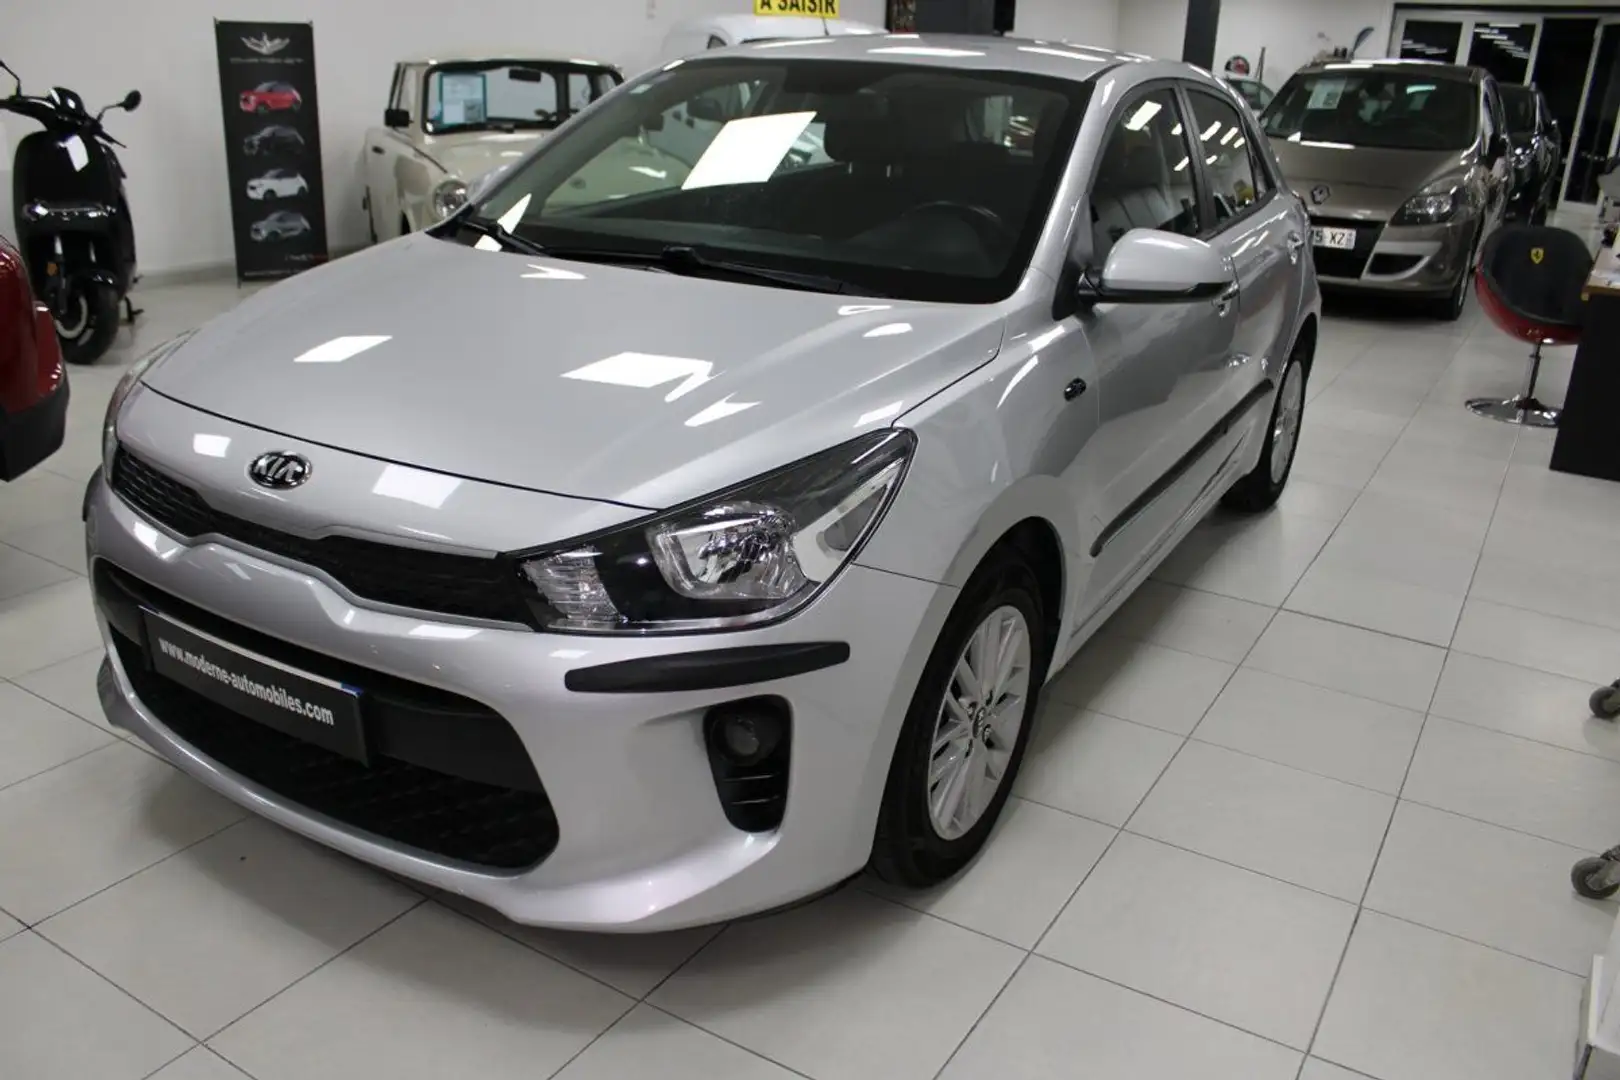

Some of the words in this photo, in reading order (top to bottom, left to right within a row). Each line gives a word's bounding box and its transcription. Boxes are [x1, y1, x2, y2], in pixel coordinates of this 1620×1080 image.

[778, 0, 836, 14] SAISIR
[253, 454, 304, 482] KIA
[158, 637, 335, 726] www.moderne-automobiles.com
